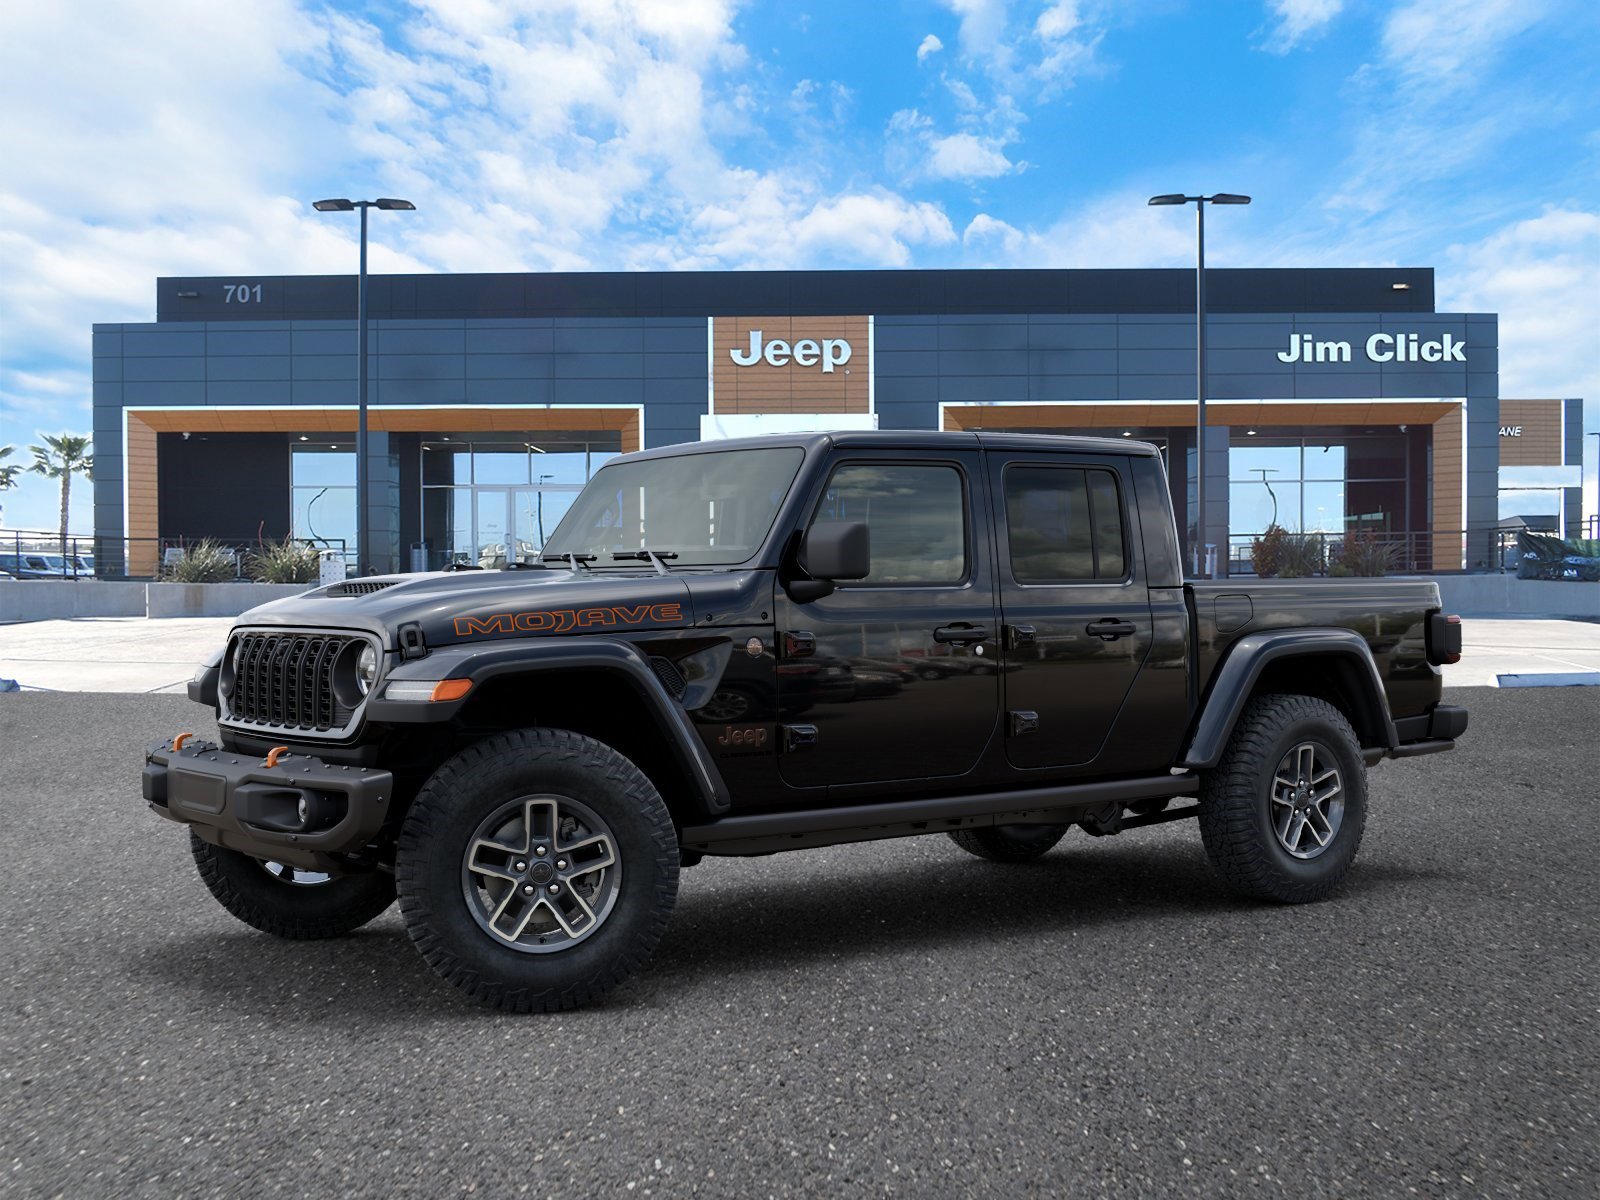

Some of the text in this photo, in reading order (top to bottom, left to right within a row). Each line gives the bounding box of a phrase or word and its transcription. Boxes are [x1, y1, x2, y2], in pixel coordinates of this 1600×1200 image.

[223, 284, 263, 304] 701
[729, 330, 852, 373] Jeep
[1276, 333, 1467, 363] Jim Click
[453, 603, 683, 636] MOJAVE
[718, 725, 768, 748] Jeep
